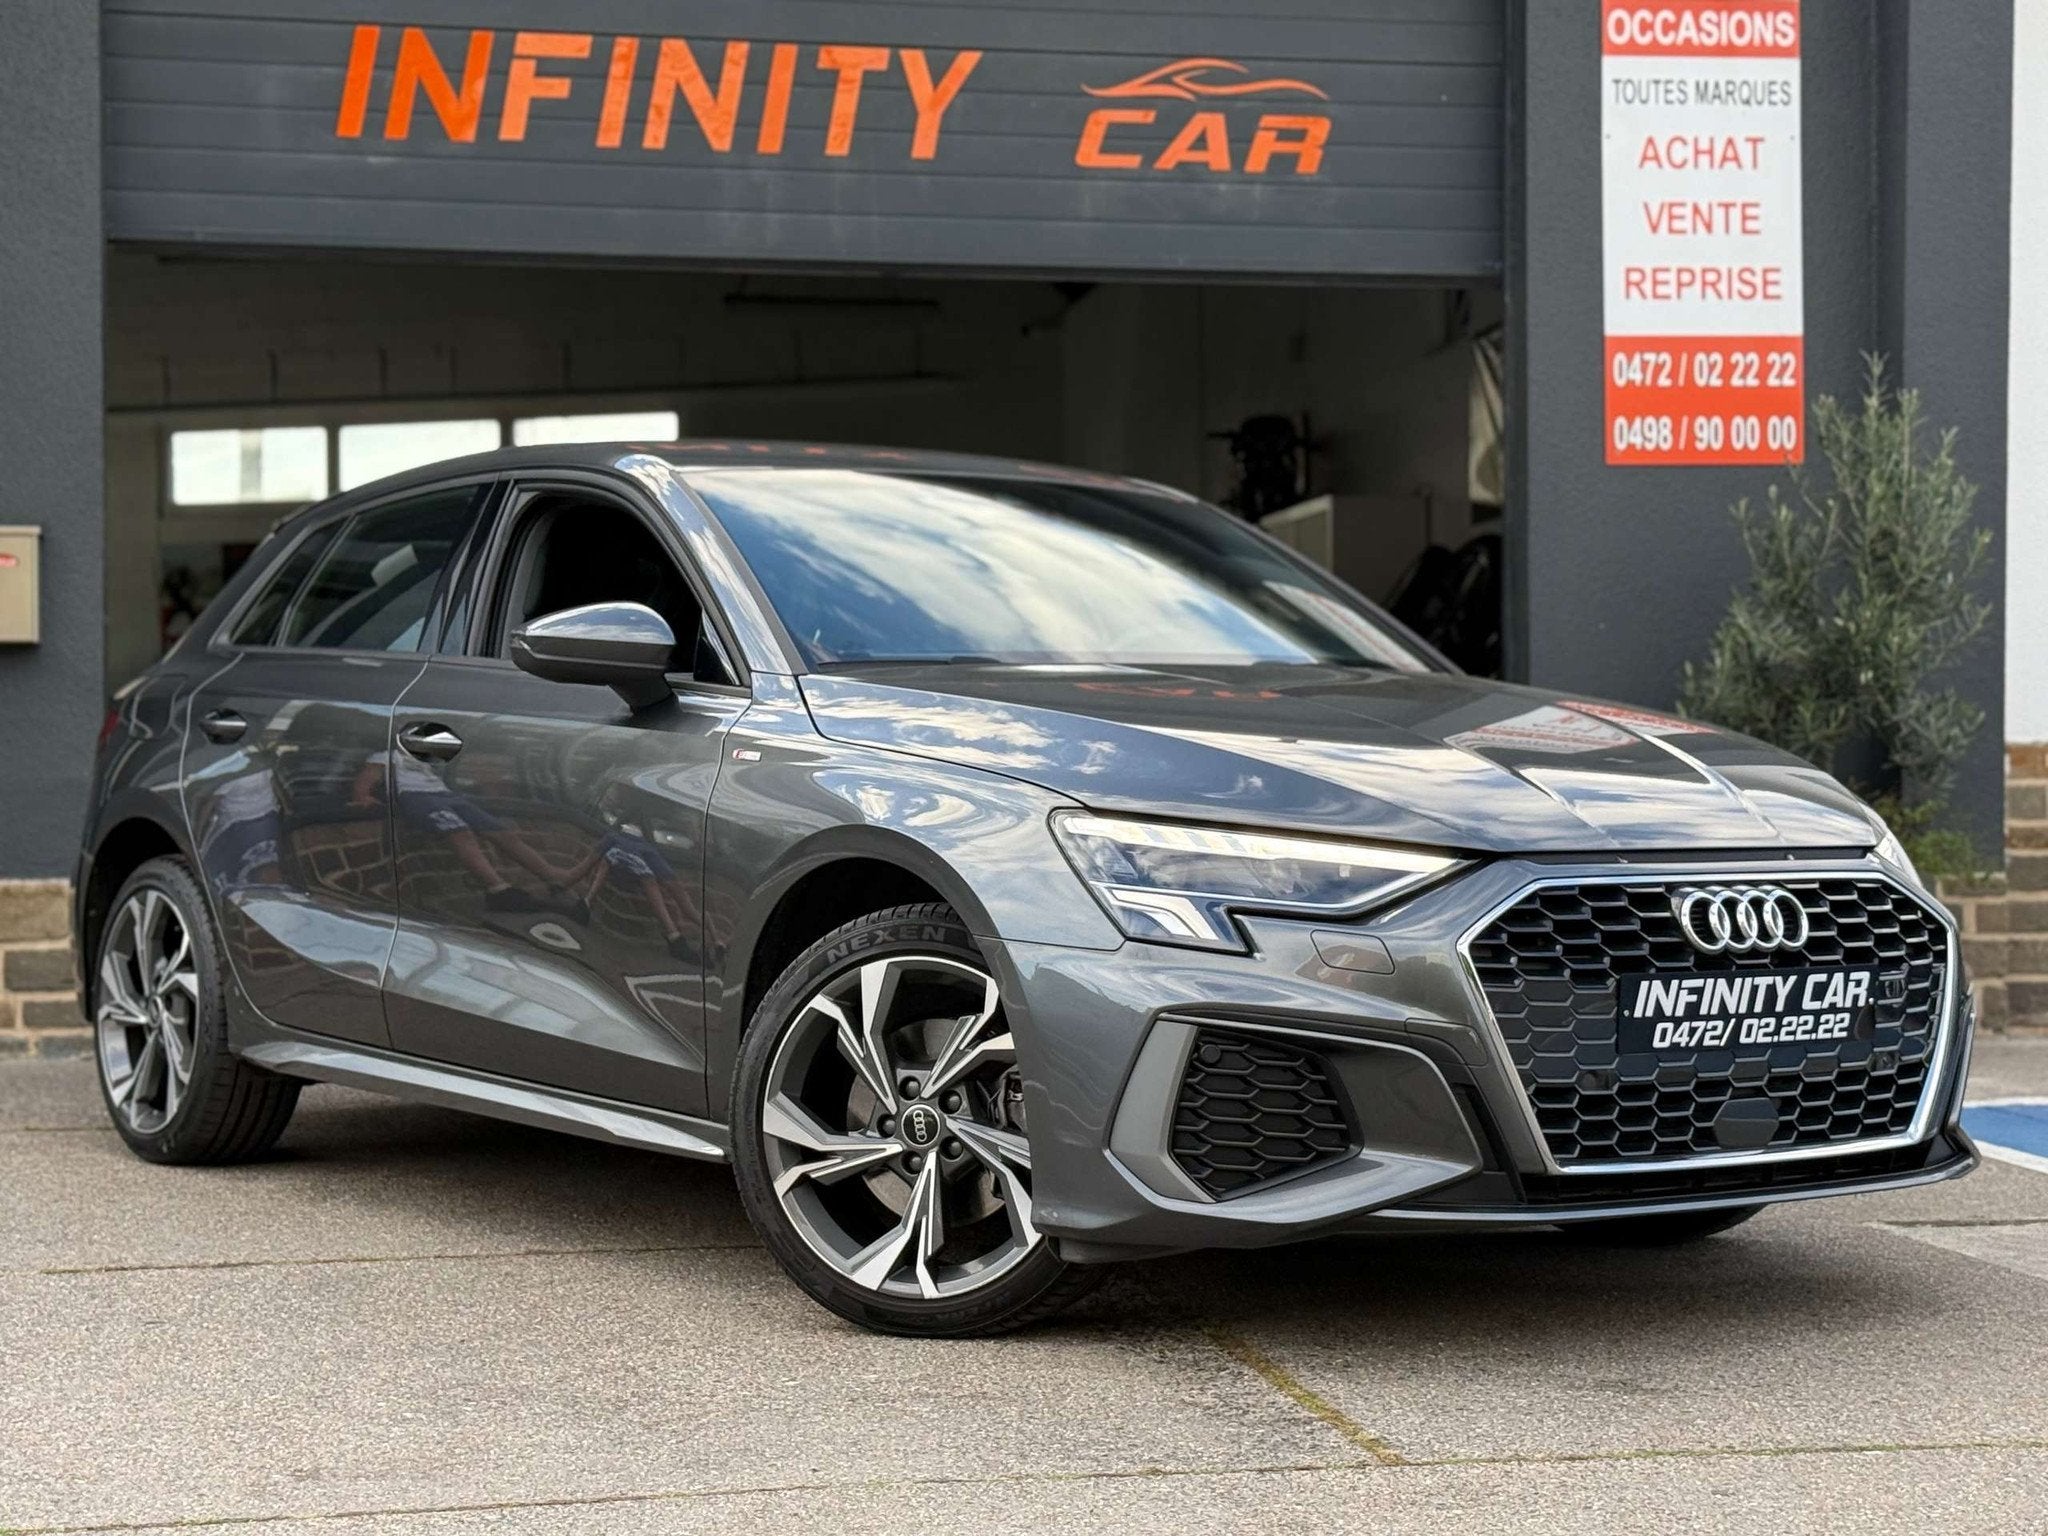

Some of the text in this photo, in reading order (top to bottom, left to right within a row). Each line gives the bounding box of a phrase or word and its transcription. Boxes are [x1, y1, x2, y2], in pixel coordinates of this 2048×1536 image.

[1606, 8, 1797, 48] OCCASIONS
[336, 24, 1332, 174] INFINITY CAR
[1611, 78, 1792, 107] TOUTES MARQUES
[1638, 135, 1765, 170] ACHAT
[1643, 201, 1761, 236] VENTE
[1624, 266, 1782, 301] REPRISE
[1613, 352, 1673, 388] 0472
[1693, 352, 1724, 387] 02
[1730, 352, 1761, 388] 22
[1766, 352, 1797, 387] 22
[1613, 415, 1674, 452] 0498
[1693, 415, 1725, 451] 90
[1730, 415, 1761, 451] 00
[1766, 415, 1797, 451] 00
[826, 925, 946, 964] NEXEN
[1633, 970, 1871, 1018] INFINITY CAR
[1652, 1012, 1851, 1049] 0472/ 02.22.22
